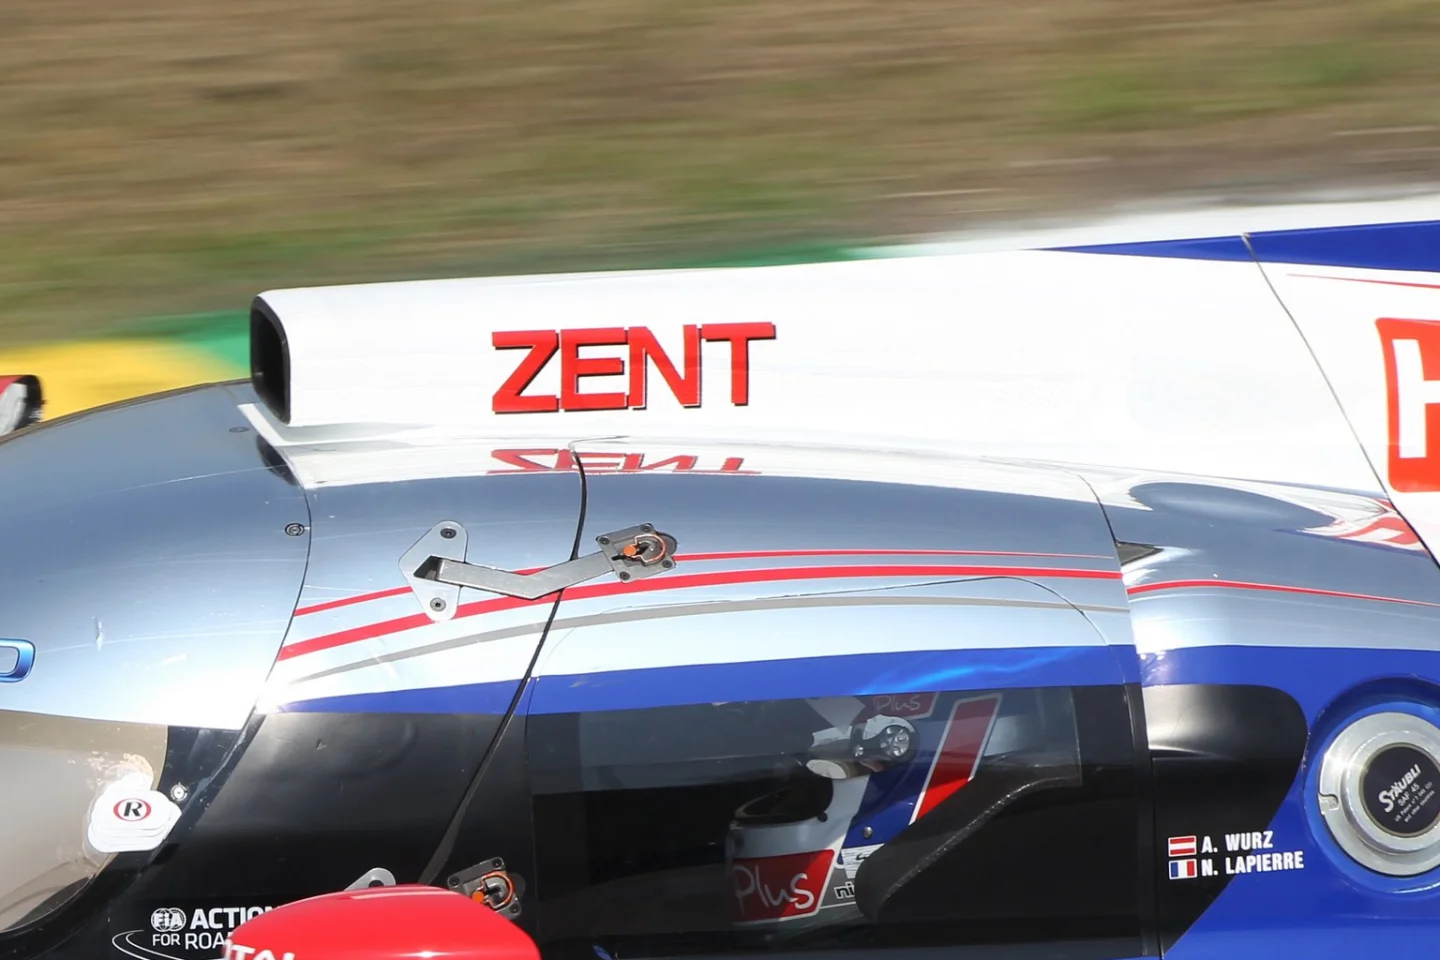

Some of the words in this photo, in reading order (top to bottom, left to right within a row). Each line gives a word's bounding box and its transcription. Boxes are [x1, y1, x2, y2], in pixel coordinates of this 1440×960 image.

[491, 321, 777, 414] ZENT
[1201, 836, 1218, 853] A.
[1225, 831, 1273, 851] WURZ
[1201, 859, 1219, 876] N.
[1225, 851, 1304, 874] LAPIERRE
[731, 864, 814, 913] Plus
[834, 881, 855, 898] ni
[190, 906, 278, 930] ACTIO
[152, 933, 181, 946] FOR
[185, 932, 234, 950] ROA
